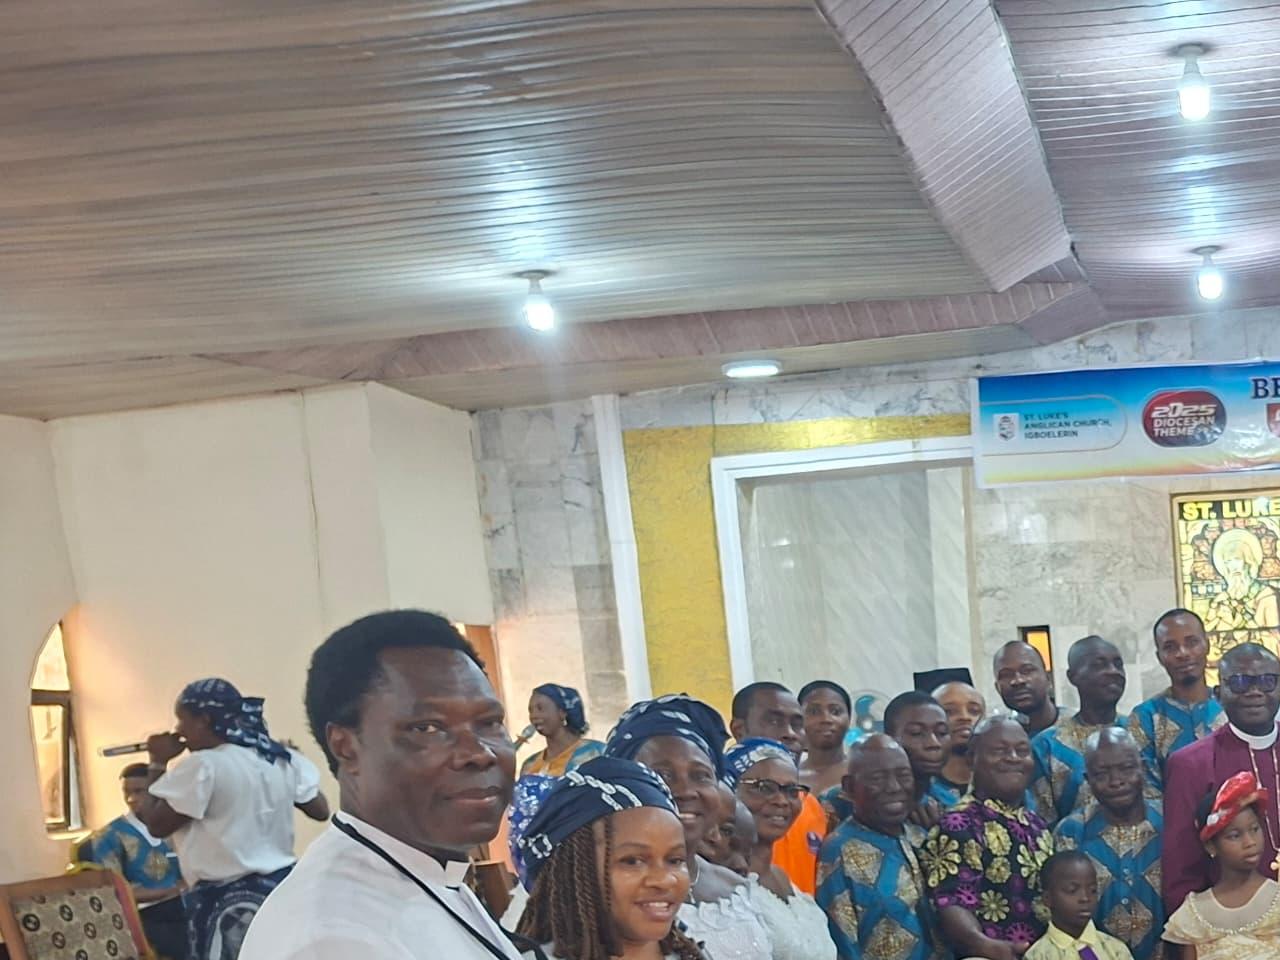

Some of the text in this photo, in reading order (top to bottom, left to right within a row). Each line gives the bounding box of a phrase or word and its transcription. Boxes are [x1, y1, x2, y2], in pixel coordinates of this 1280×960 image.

[1151, 402, 1217, 418] 2025
[1024, 420, 1070, 429] ANGLICAN
[1153, 415, 1216, 427] DIOCESAN
[1153, 426, 1195, 437] THEME
[1182, 501, 1217, 520] ST.
